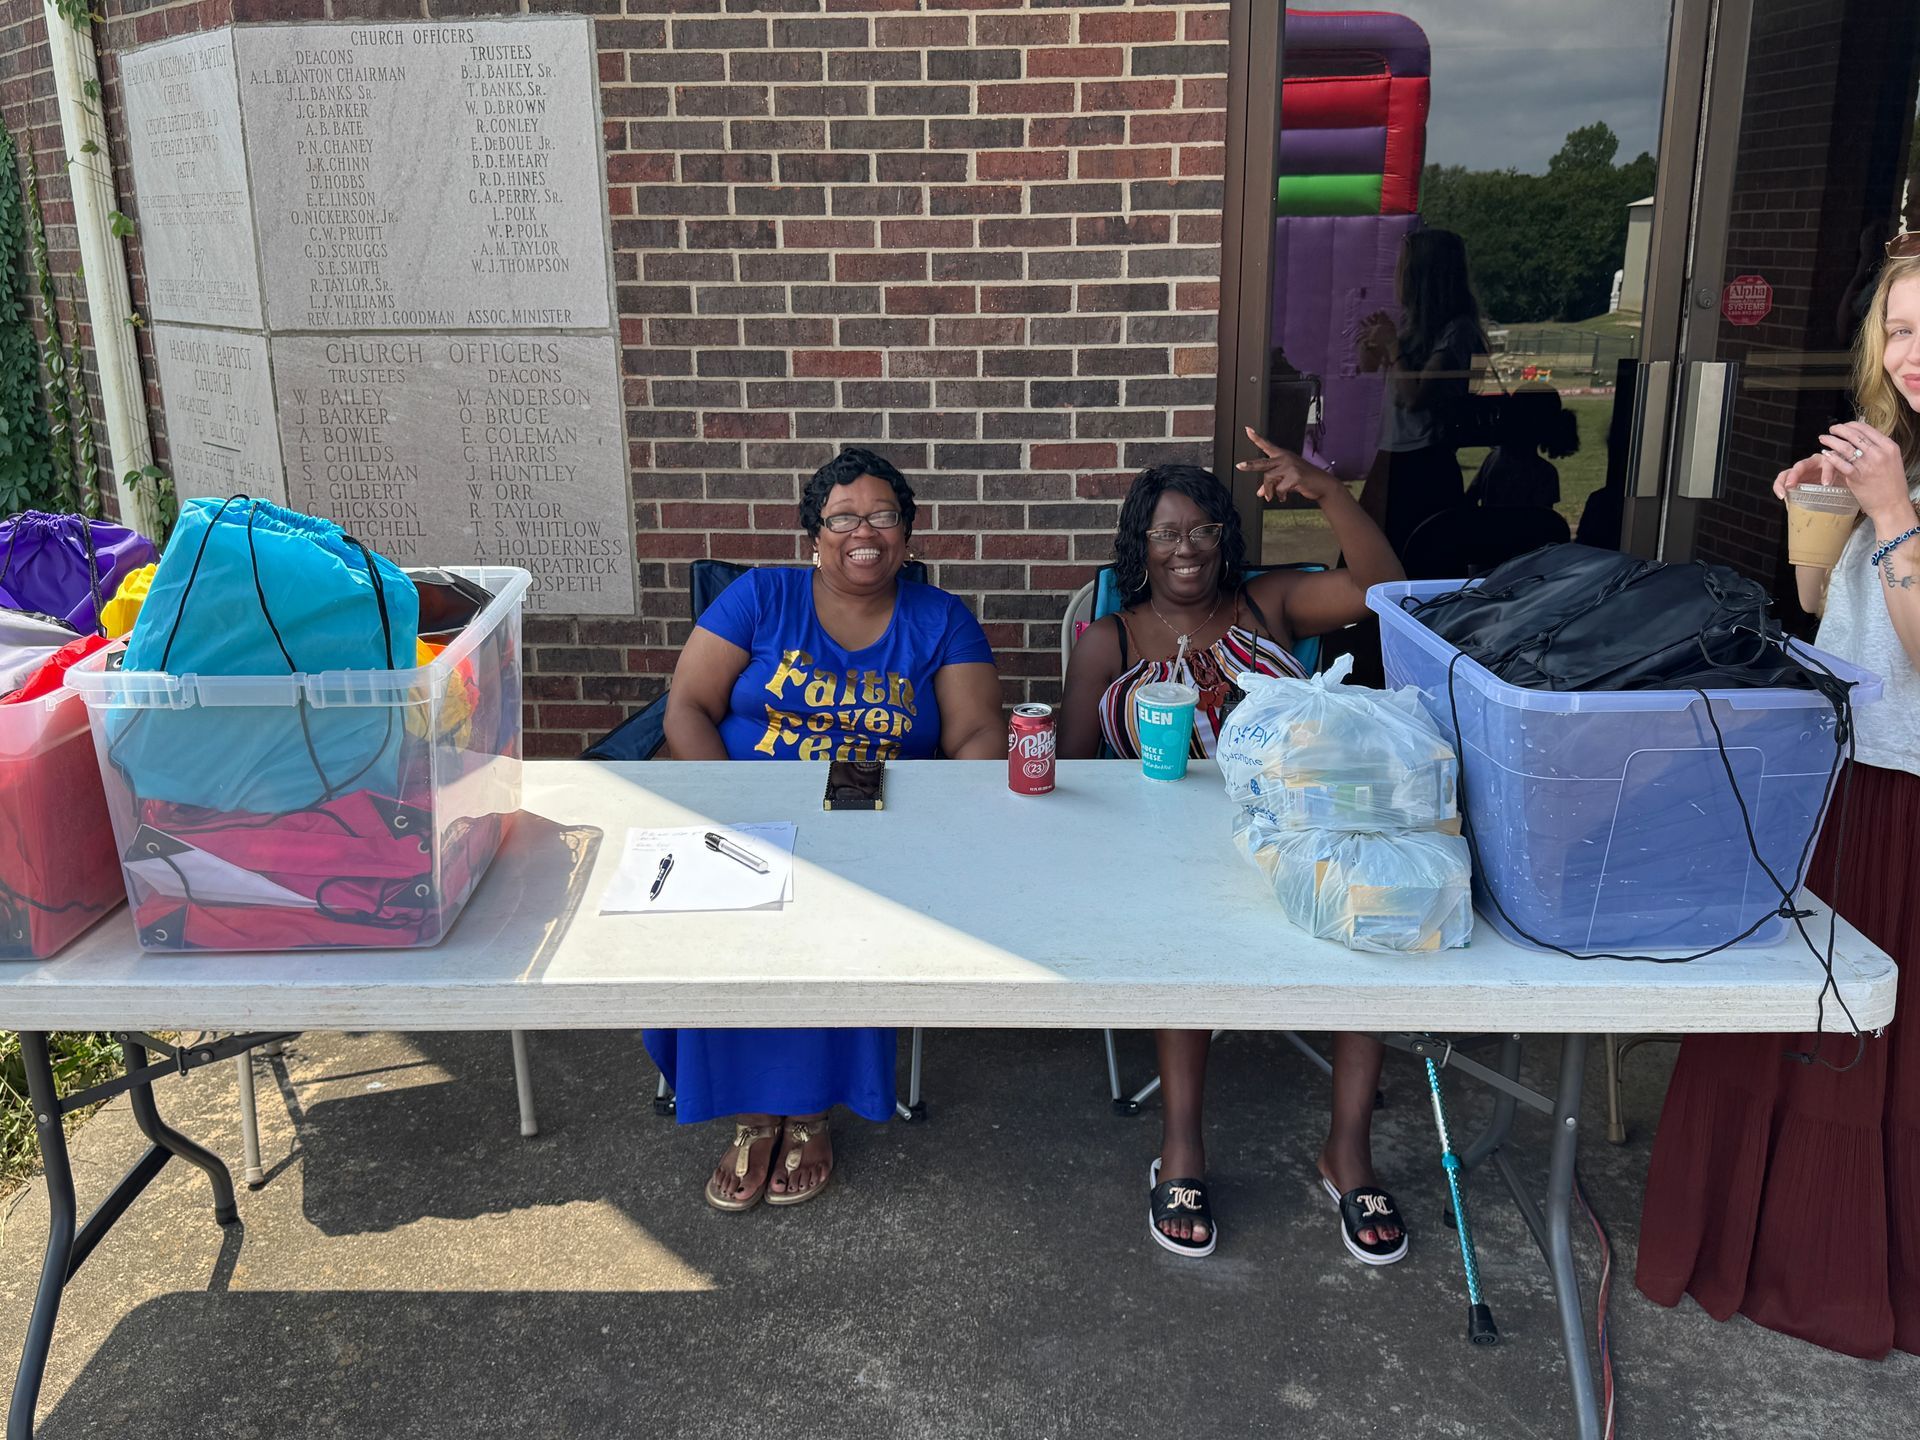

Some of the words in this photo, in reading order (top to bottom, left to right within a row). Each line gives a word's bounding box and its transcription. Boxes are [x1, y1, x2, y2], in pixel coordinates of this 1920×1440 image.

[351, 30, 404, 46] CHURCH
[413, 28, 474, 44] OFFICERS
[296, 49, 354, 65] DEACONS
[470, 45, 532, 61] TRUSTEES
[337, 66, 406, 83] CHAIRMAN
[1730, 285, 1766, 299] Alpha
[1728, 303, 1765, 311] SYSTEMS
[308, 312, 334, 327] REV.
[337, 311, 376, 326] LARRY
[169, 338, 211, 366] HARMONY
[215, 344, 252, 371] BAPTIST
[326, 343, 423, 364] CHURCH
[449, 343, 559, 364] OFFICERS
[194, 369, 233, 396] CHURCH
[328, 369, 406, 384] TRUSTEES
[489, 369, 562, 384] DEACONS
[293, 389, 310, 406] W.
[320, 389, 384, 406] BAILEY
[457, 389, 476, 406] M.
[485, 388, 591, 406] ANDERSON
[296, 408, 309, 425] J.
[319, 408, 390, 425] BARKER
[459, 408, 475, 424] O.
[486, 408, 549, 424] BRUCE
[299, 427, 315, 444] A.
[323, 427, 383, 444] BOWIE
[462, 427, 477, 444] E.
[485, 427, 577, 444] COLEMAN
[301, 446, 315, 463] E.
[324, 446, 394, 463] CHILDS
[463, 446, 479, 463] C.
[488, 446, 557, 463] HARRIS
[302, 464, 315, 481] S.
[327, 464, 418, 481] COLEMAN
[466, 465, 480, 482] J.
[490, 465, 577, 482] HUNTLEY
[305, 483, 318, 499] T.
[329, 483, 406, 499] GILBERT
[468, 484, 484, 500] W.
[496, 484, 534, 500] ORR
[331, 501, 417, 518] HICKSON
[470, 503, 486, 518] R.
[491, 502, 564, 518] TAYLOR
[471, 521, 485, 537] T.
[495, 521, 508, 537] S.
[516, 521, 602, 537] WHITLOW
[474, 540, 491, 556] A.
[498, 539, 623, 556] HOLDERNESS
[765, 649, 917, 716] Faith
[754, 703, 901, 760] Fear
[806, 707, 913, 748] over
[1037, 730, 1053, 746] Dr
[1031, 764, 1042, 774] 23
